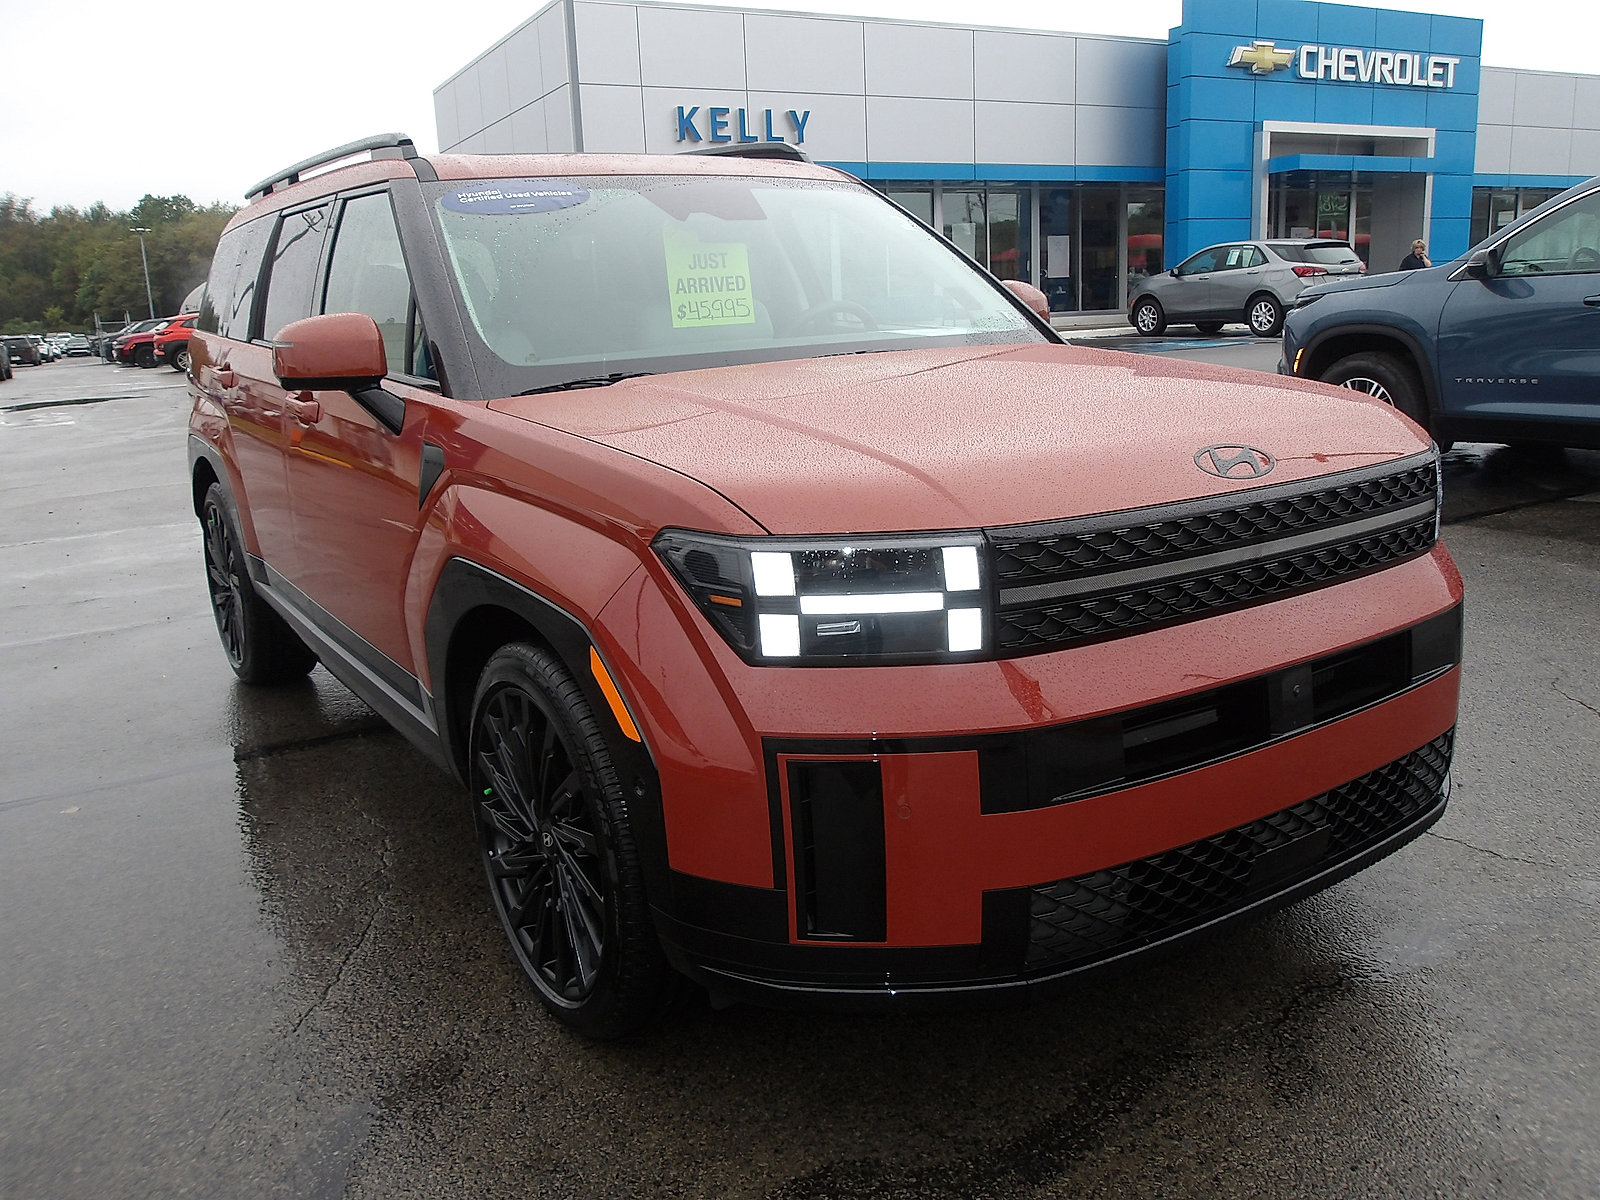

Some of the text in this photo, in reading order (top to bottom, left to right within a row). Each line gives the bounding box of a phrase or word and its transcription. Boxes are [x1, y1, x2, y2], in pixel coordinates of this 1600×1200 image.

[1297, 44, 1461, 88] CHEVROLET
[675, 105, 811, 144] KELLY
[457, 189, 502, 199] Hyundai
[459, 194, 504, 204] Certified
[688, 252, 728, 270] JUST
[675, 275, 746, 294] ARRIVED
[1455, 377, 1539, 385] TRAVERSE
